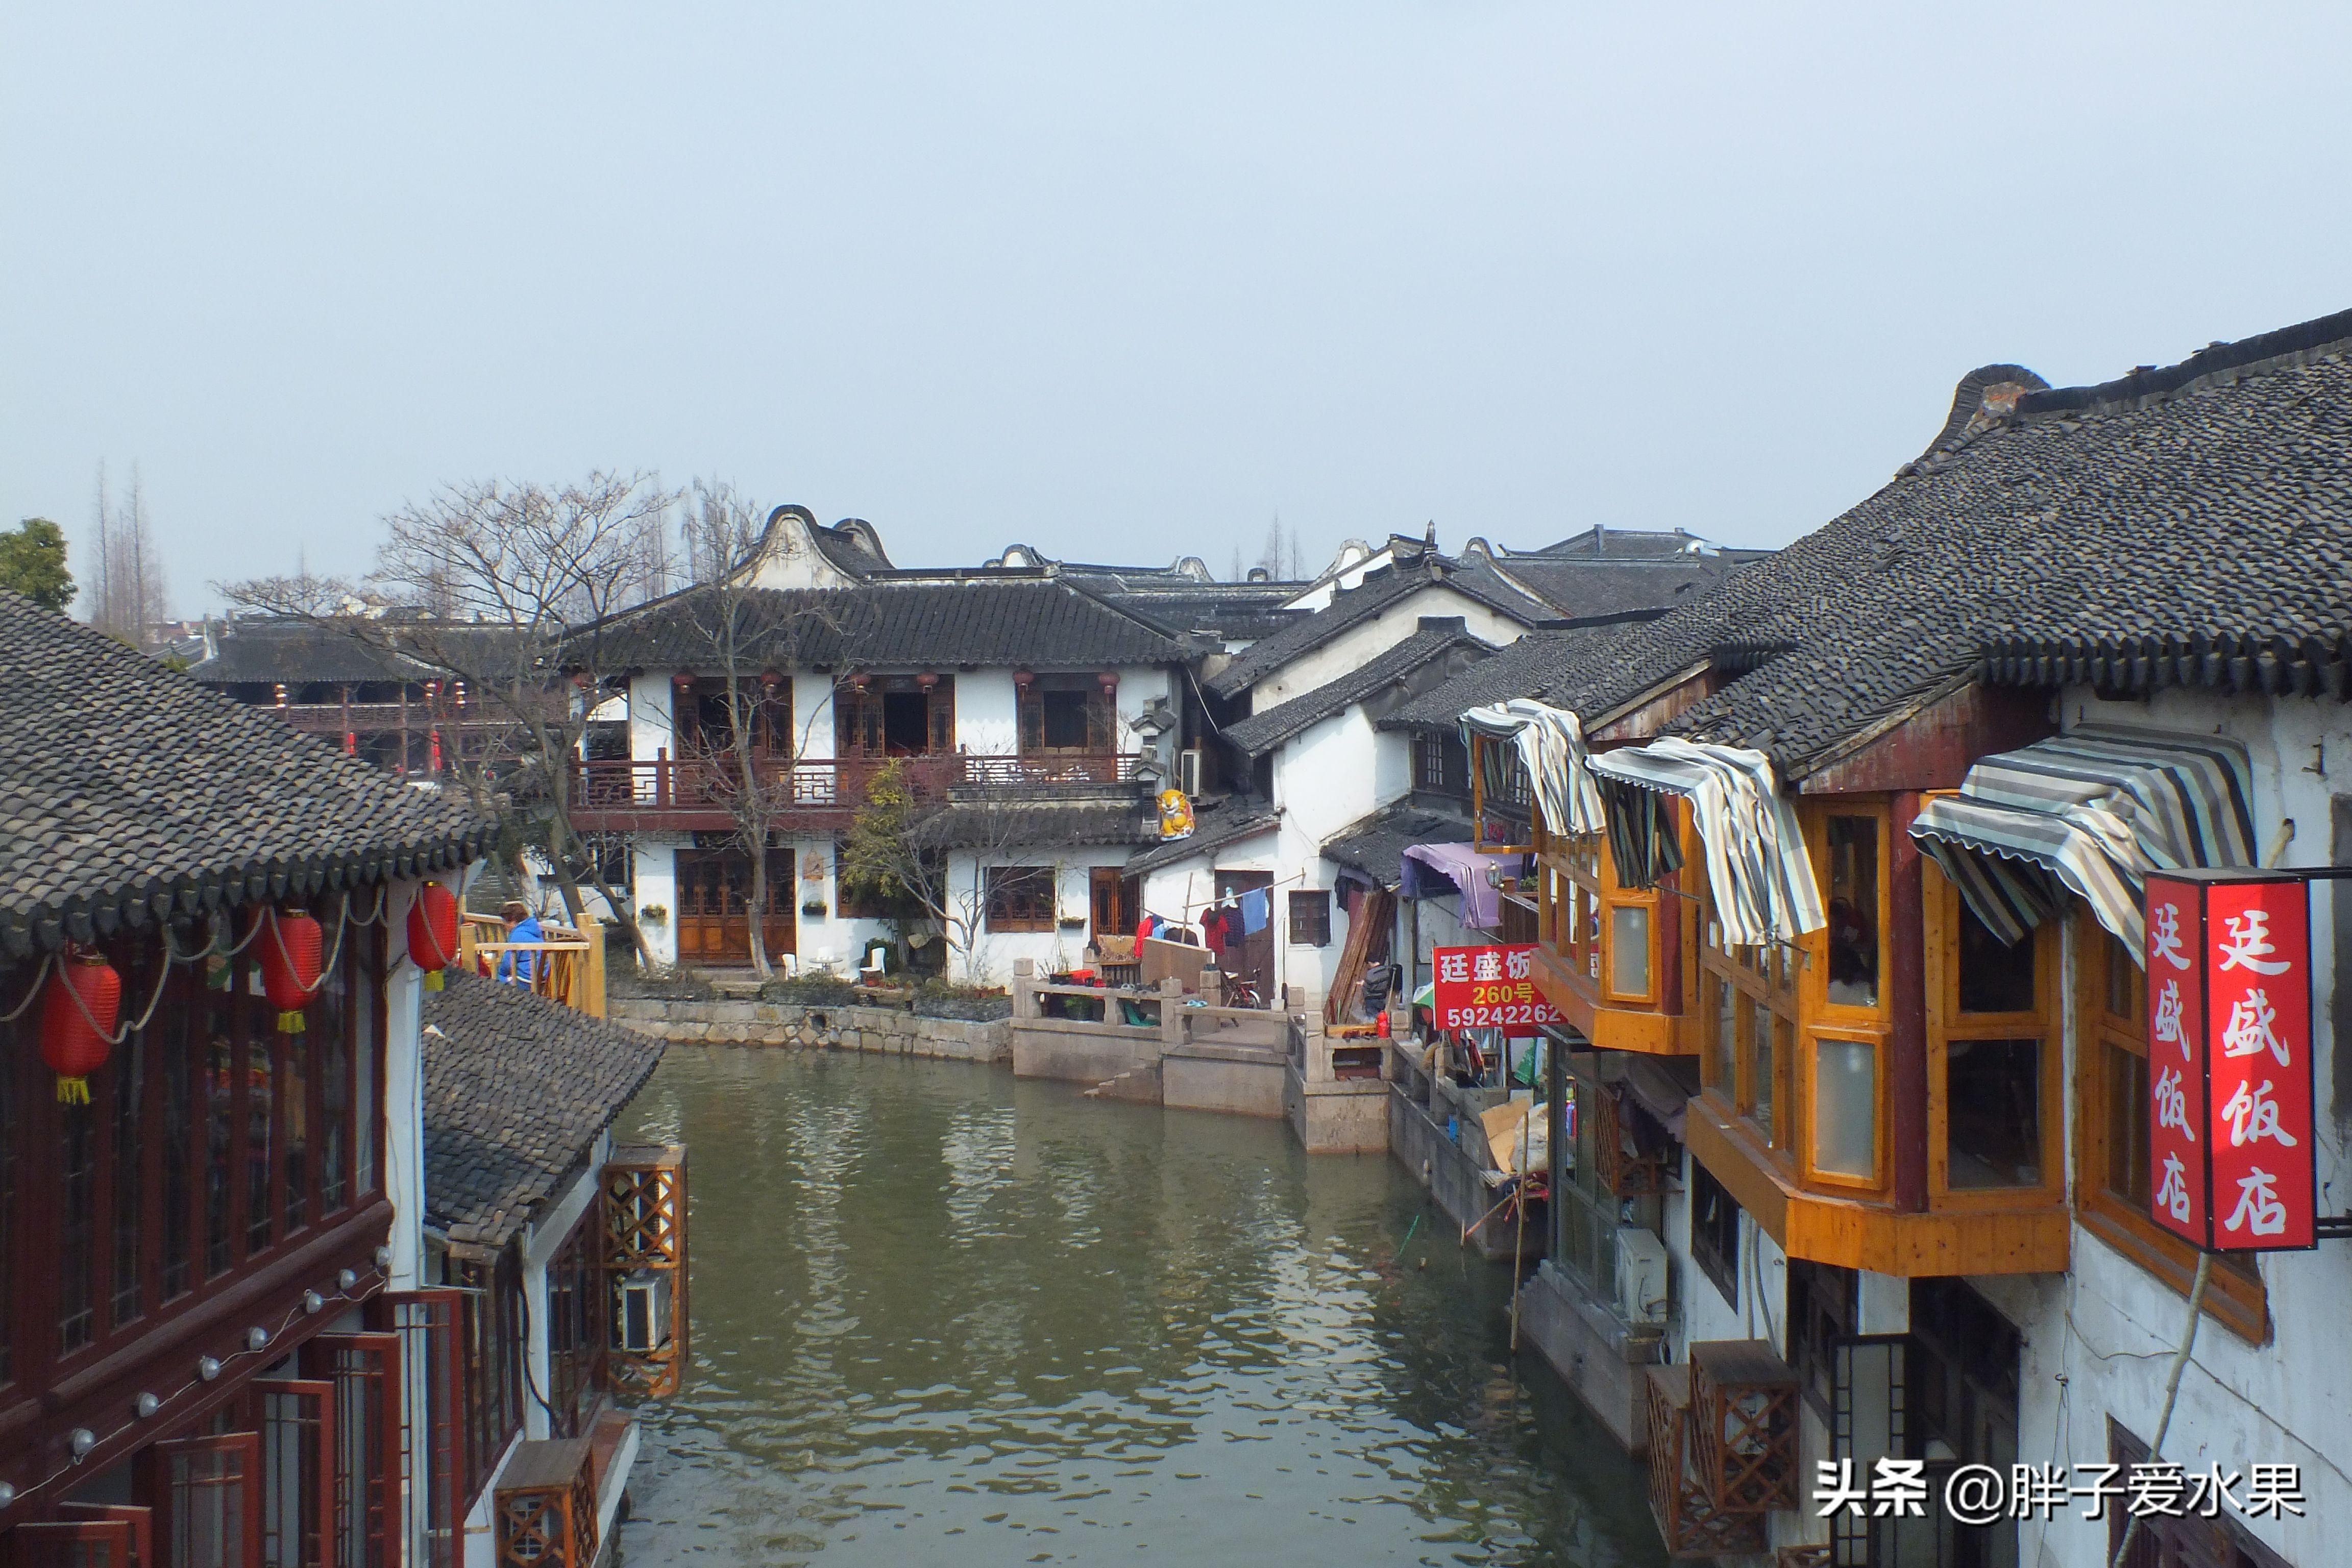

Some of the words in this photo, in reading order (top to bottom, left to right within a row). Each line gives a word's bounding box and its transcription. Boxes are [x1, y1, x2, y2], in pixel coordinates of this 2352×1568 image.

[1448, 1003, 1561, 1027] 59242262
[1473, 983, 1534, 1004] 260号
[2152, 903, 2195, 1223] 廷盛饭店
[2219, 910, 2297, 1236] 廷盛饭店
